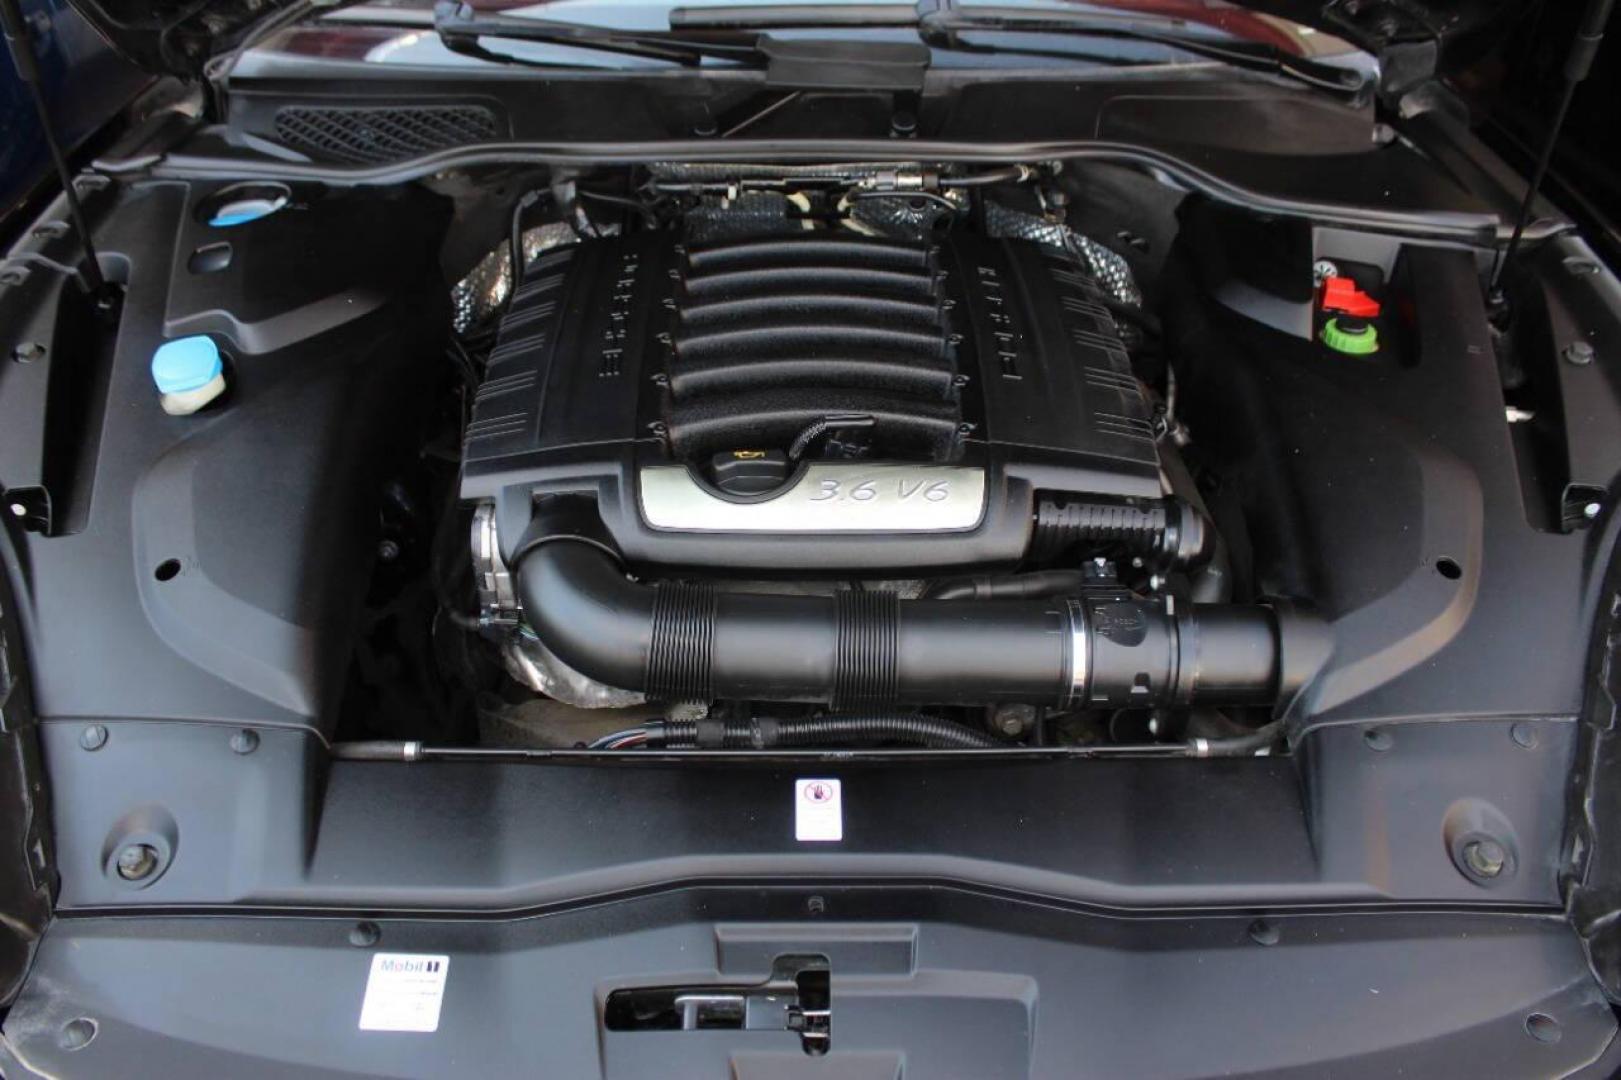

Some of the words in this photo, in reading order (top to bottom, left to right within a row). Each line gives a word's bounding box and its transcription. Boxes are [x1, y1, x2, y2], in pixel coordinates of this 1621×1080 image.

[809, 479, 877, 501] 3.6
[898, 479, 950, 502] V6
[381, 959, 424, 972] Mobil
